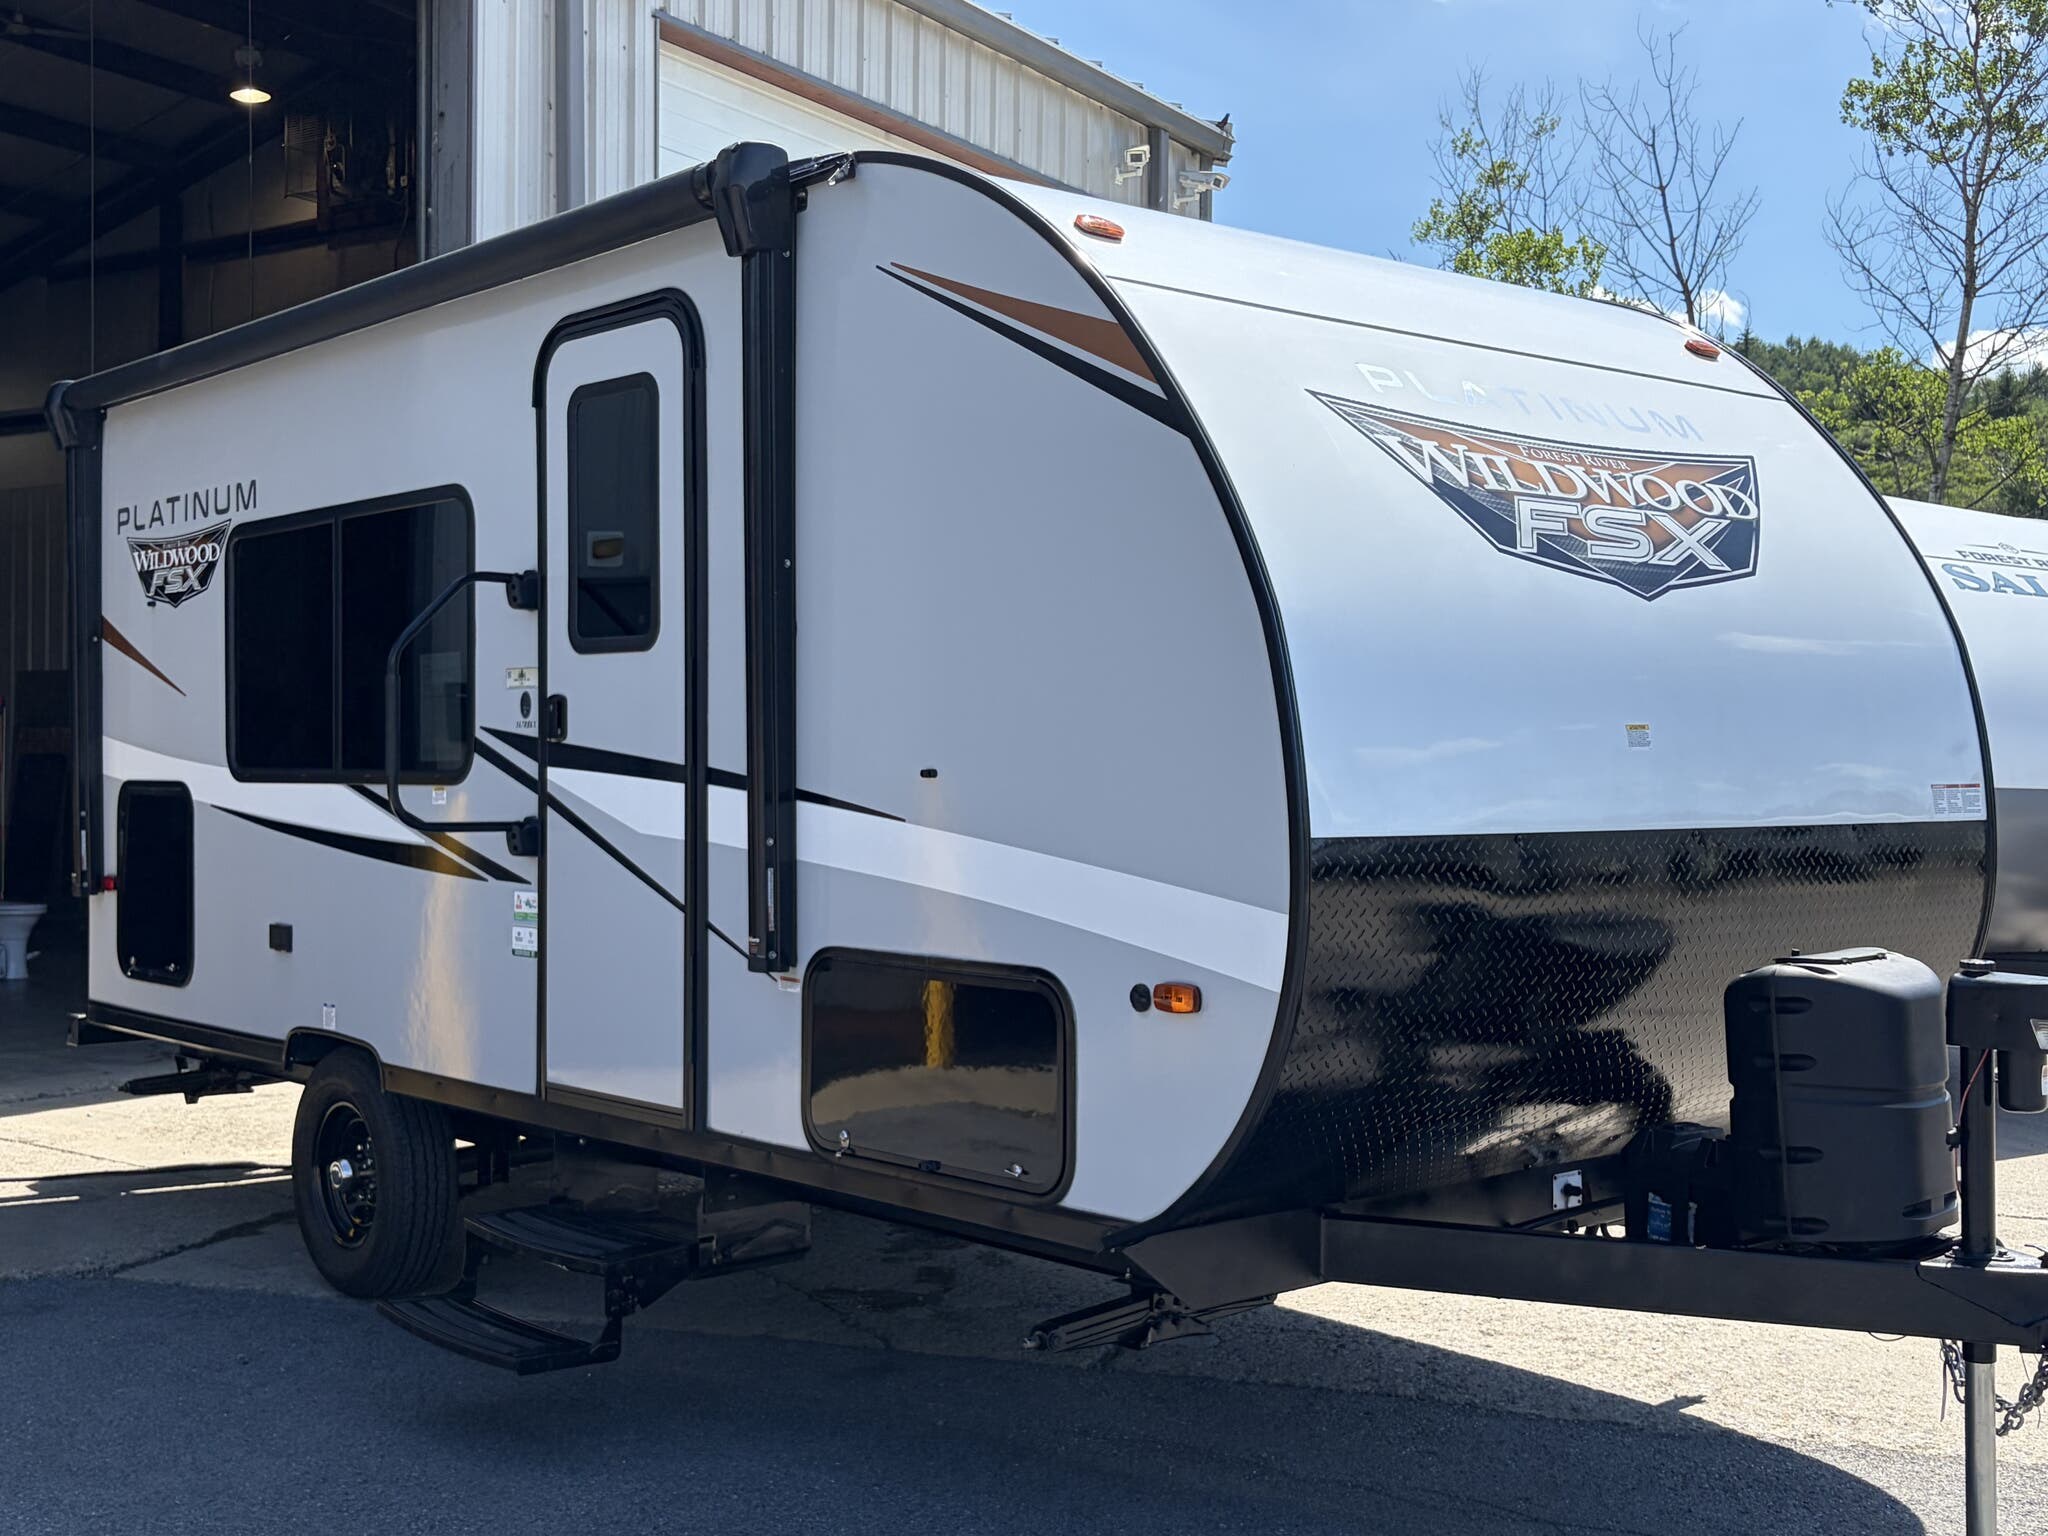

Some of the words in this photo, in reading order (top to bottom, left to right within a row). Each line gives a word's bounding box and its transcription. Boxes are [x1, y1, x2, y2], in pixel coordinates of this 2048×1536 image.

[1354, 362, 1705, 442] PLATINUM
[1374, 434, 1759, 520] WILDWOOD
[1518, 445, 1580, 464] FOREST
[1579, 452, 1631, 471] RIVER
[117, 479, 257, 535] PLATINUM
[1514, 494, 1732, 572] FSX
[132, 542, 221, 573] WILDWOOD
[149, 562, 209, 597] FSX
[1954, 549, 2032, 566] FOREST
